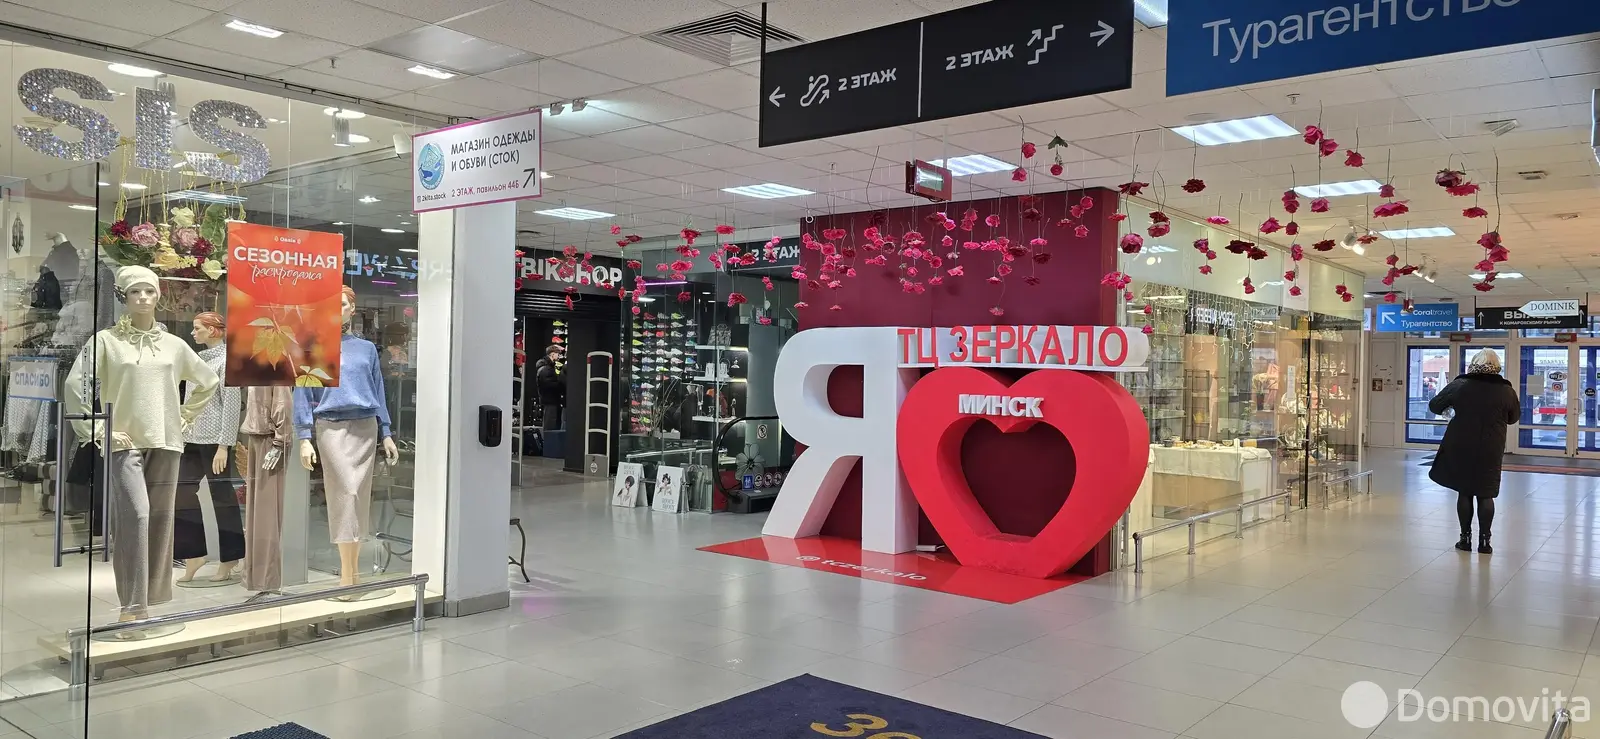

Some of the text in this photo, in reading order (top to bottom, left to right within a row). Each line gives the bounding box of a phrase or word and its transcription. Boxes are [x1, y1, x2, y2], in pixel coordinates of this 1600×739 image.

[1203, 0, 1520, 63] Турагентст
[946, 44, 1014, 71] 2 ЭТАЖ
[838, 68, 897, 91] 2 ЭТАЖ
[451, 129, 536, 155] МАГАЗИН ОДЕЖДЫ
[451, 149, 520, 172] И ОБУВИ (СТОК)
[451, 188, 456, 198] 2
[476, 183, 507, 194] павильон
[507, 180, 520, 190] 44Б
[234, 246, 338, 270] СЕЗОННАЯ
[251, 264, 323, 286] распродажа
[1530, 302, 1575, 311] DOMINIK
[1401, 320, 1453, 328] Турагентство
[897, 325, 1129, 368] ТЦ ЗЕРКАЛО
[15, 372, 50, 387] СПАСИБО
[959, 394, 1044, 418] МИНСК
[762, 326, 899, 555] Я
